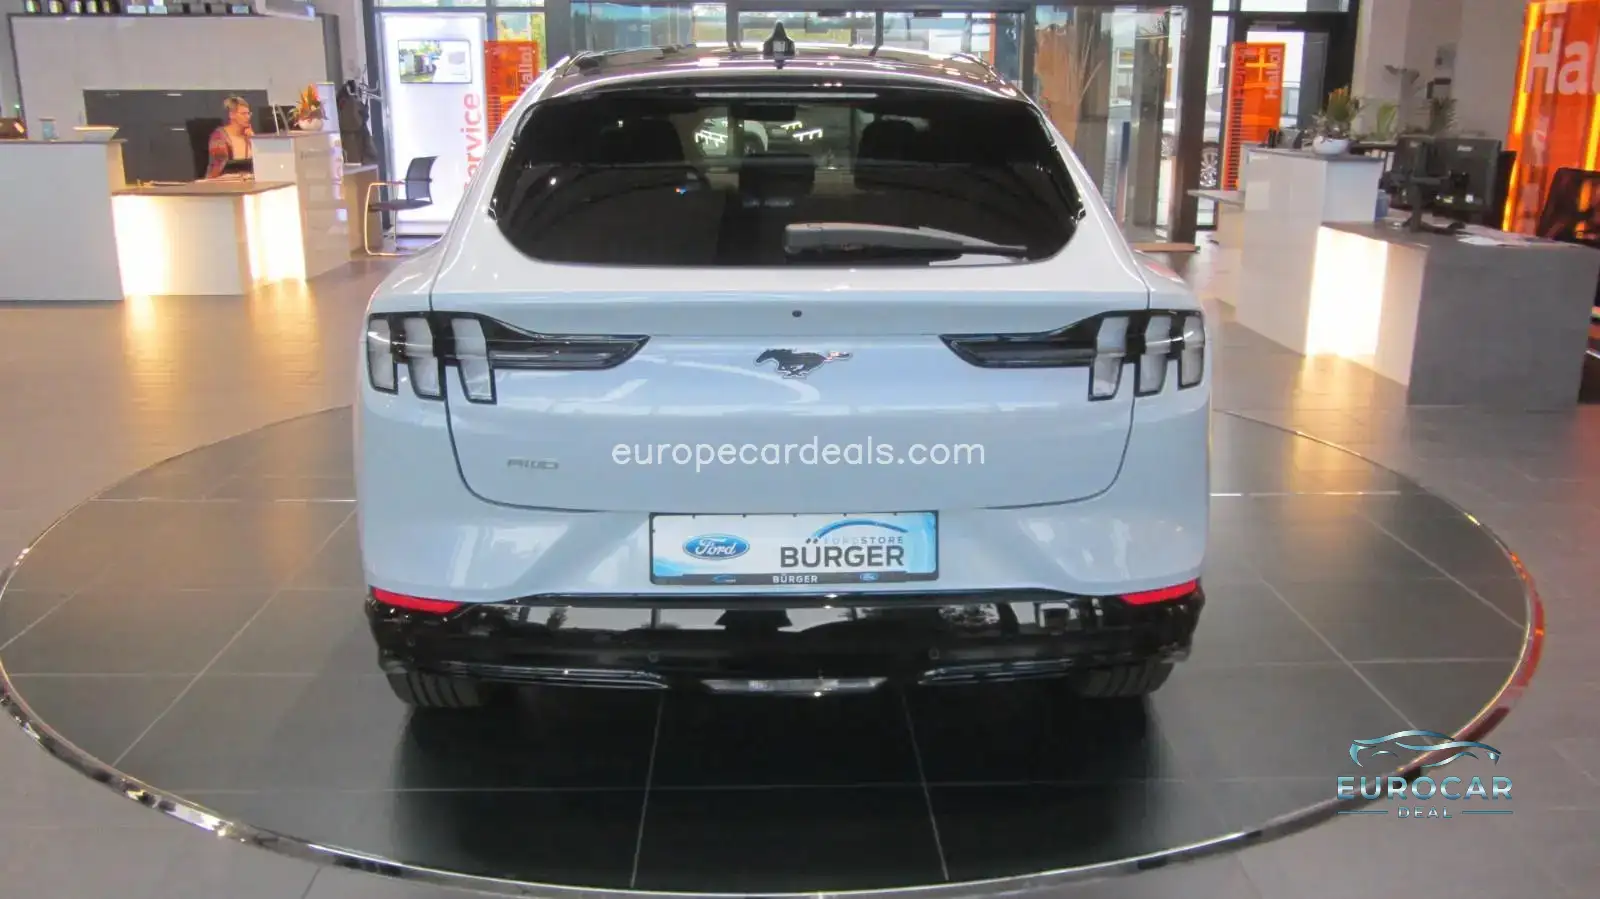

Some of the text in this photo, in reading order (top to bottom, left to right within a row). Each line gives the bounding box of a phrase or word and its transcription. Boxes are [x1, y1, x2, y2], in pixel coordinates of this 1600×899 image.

[695, 537, 737, 556] Ford
[780, 538, 905, 568] BÜRGER
[772, 574, 819, 584] BÜRGER
